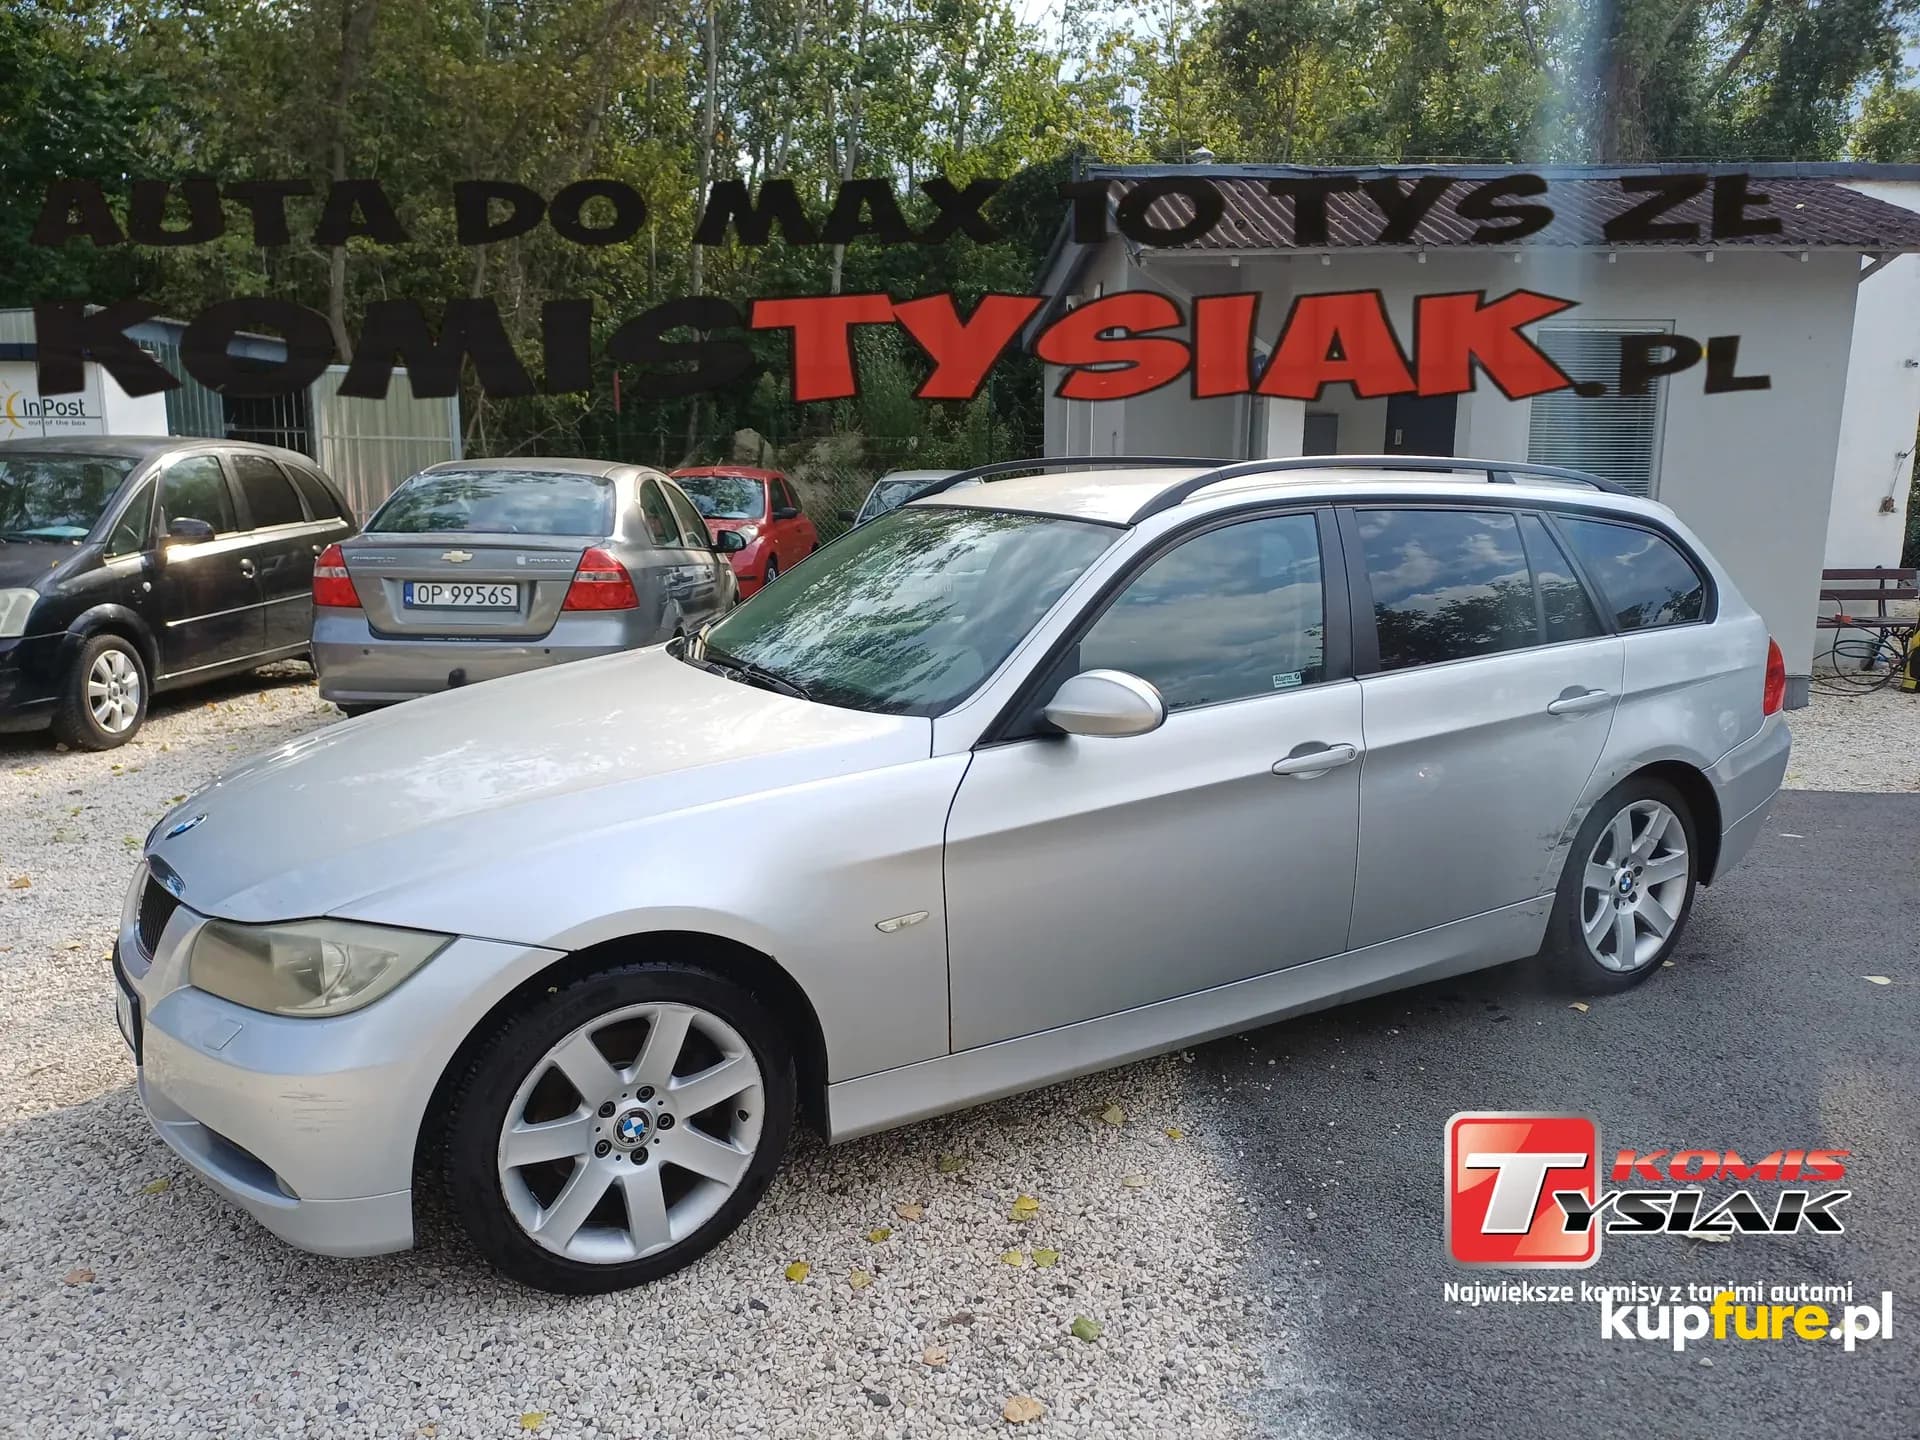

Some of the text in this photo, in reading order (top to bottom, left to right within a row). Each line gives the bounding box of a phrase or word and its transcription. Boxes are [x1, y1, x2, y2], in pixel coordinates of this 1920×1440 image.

[23, 398, 86, 417] InPost
[417, 585, 512, 606] OP 9956S
